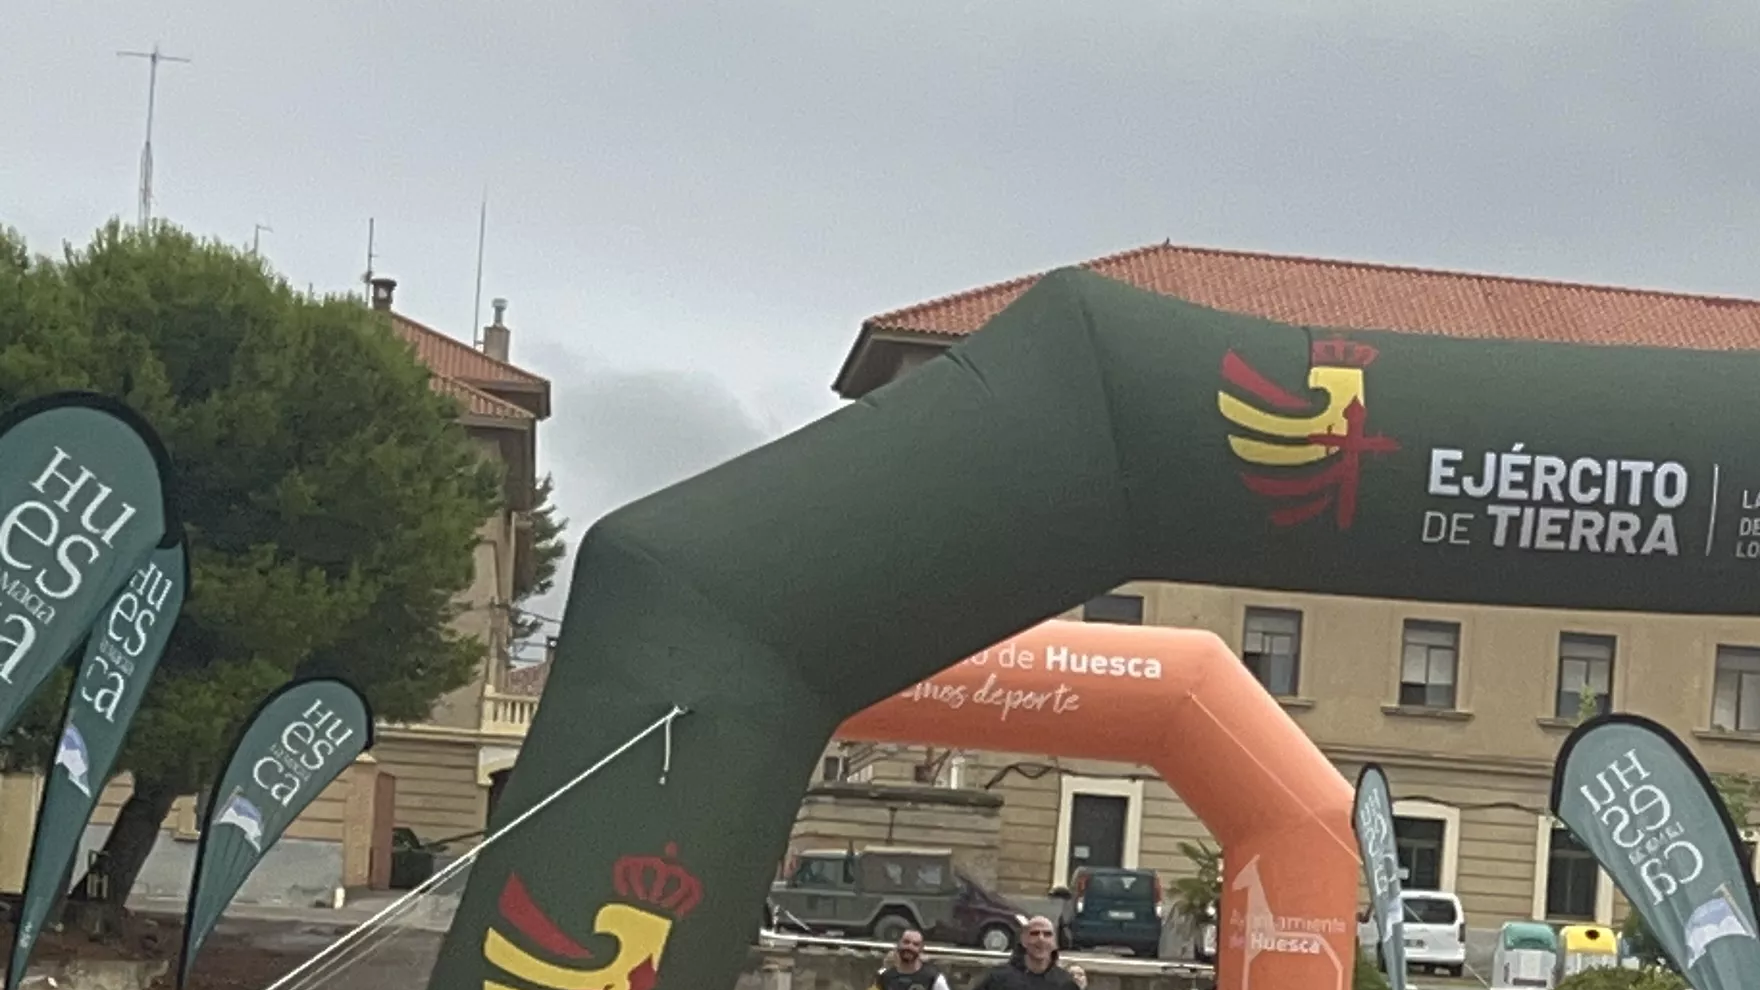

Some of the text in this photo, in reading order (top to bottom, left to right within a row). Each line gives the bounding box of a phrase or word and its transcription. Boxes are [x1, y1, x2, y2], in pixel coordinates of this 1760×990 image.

[1428, 442, 1689, 508] EJÉRCITO
[1421, 504, 1679, 556] DE TIERRA
[998, 642, 1034, 669] de
[1046, 645, 1162, 679] Huesca
[972, 673, 1080, 721] deporte
[1250, 932, 1321, 954] Huesca
